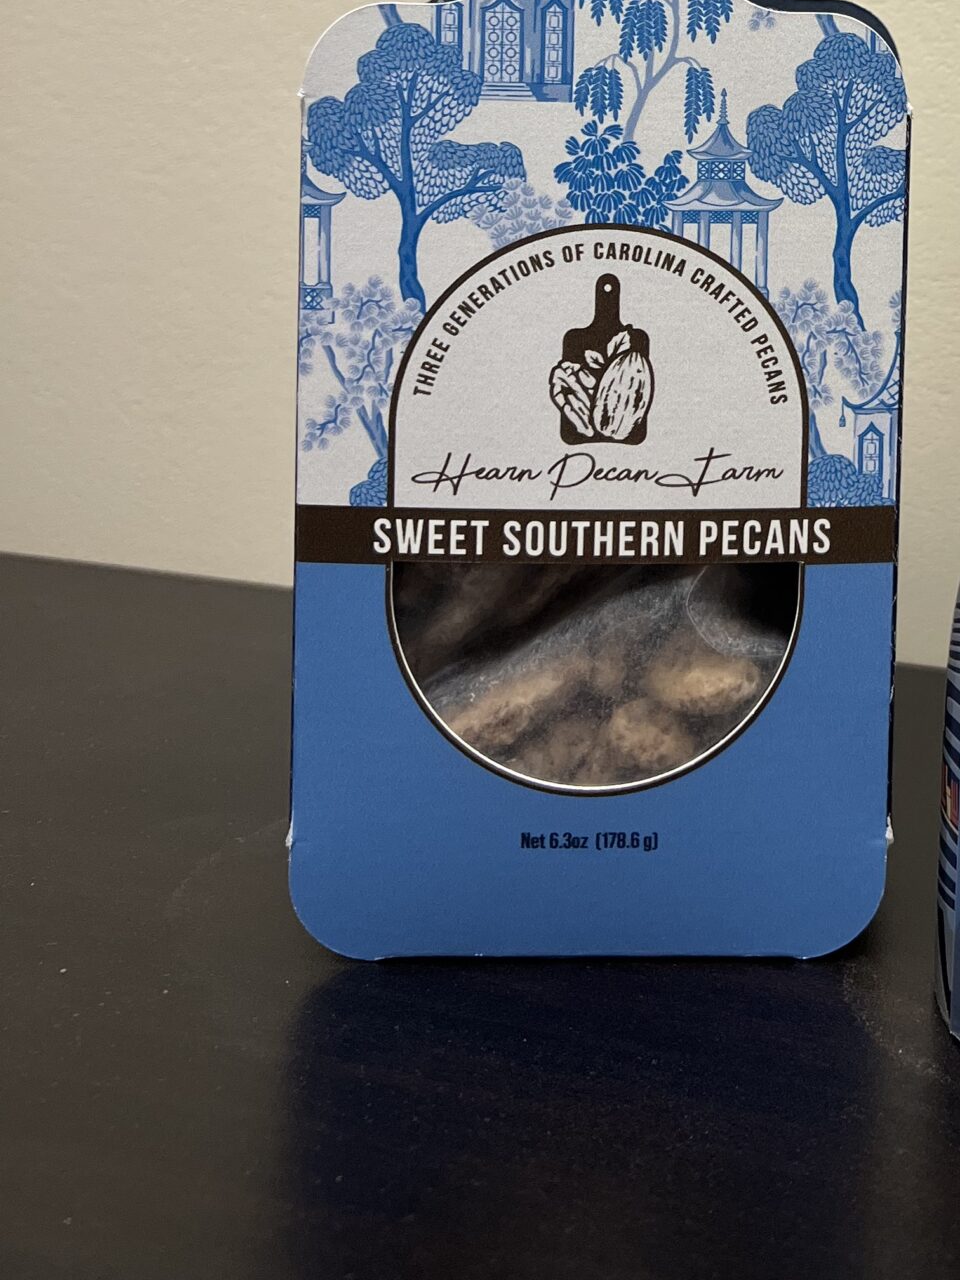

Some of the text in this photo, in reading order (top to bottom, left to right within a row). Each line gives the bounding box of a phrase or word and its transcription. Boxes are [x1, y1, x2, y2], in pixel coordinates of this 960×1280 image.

[413, 241, 787, 405] THREE GENERATIONS OF CAROLINA CRAFTED PECANS
[411, 447, 784, 500] Hearn Pecan Farm
[373, 518, 831, 557] SWEET SOUTHERN PECANS
[521, 832, 546, 849] Net
[550, 832, 589, 849] 6.3oz
